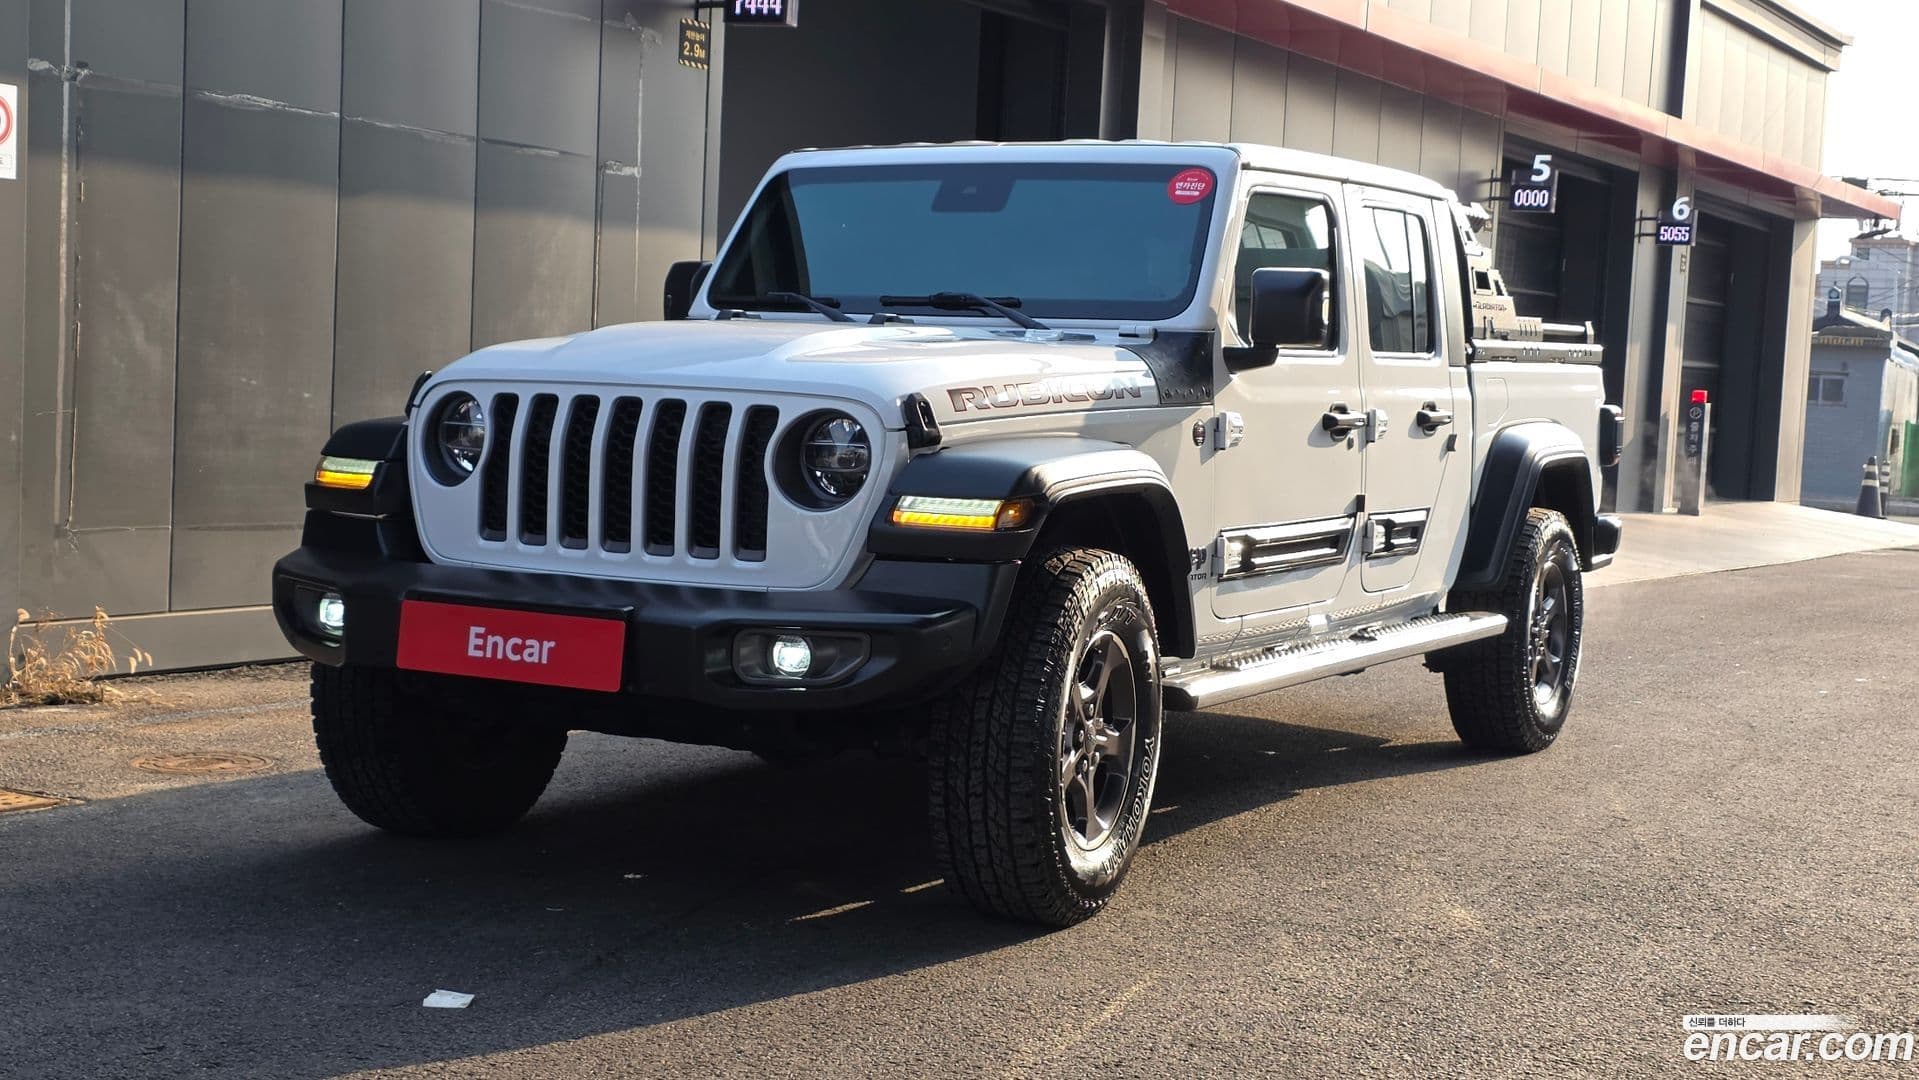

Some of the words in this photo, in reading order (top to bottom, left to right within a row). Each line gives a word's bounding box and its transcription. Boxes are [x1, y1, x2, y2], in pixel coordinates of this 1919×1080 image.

[1531, 154, 1552, 182] 5
[1514, 189, 1549, 207] 0000
[1672, 196, 1691, 221] 6
[1659, 225, 1690, 242] 5055
[947, 375, 1142, 413] RUBICON
[467, 626, 556, 664] Encar
[1102, 736, 1155, 876] YOKOHAMA
